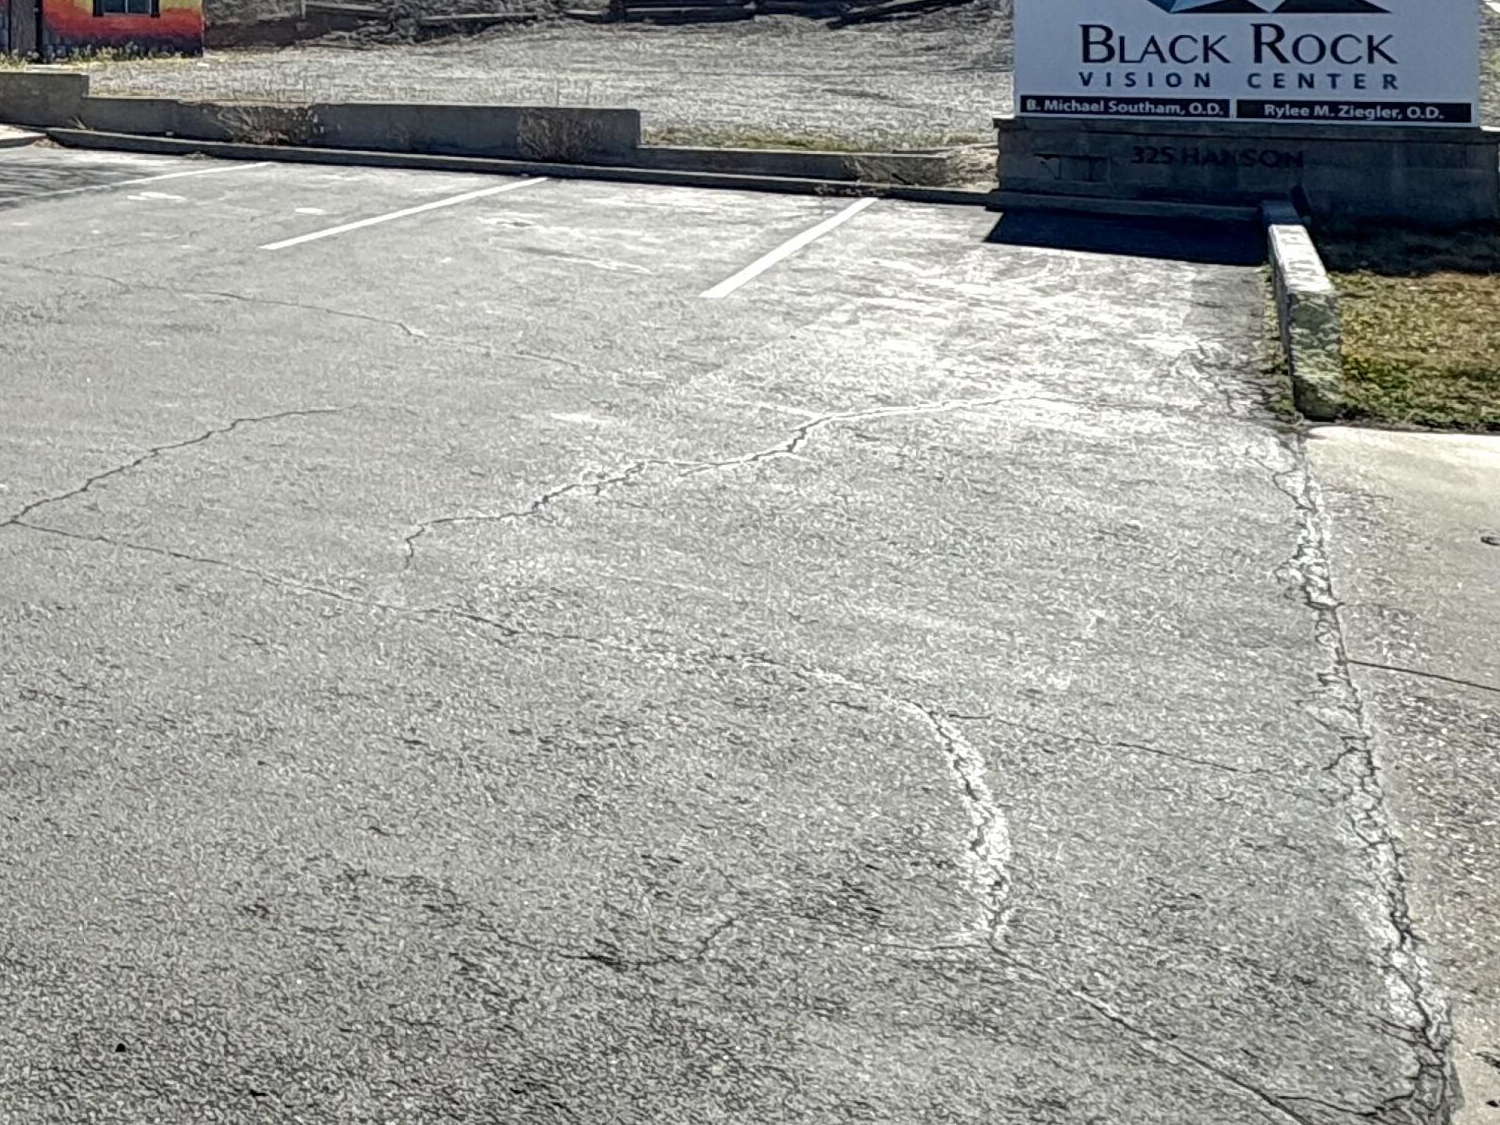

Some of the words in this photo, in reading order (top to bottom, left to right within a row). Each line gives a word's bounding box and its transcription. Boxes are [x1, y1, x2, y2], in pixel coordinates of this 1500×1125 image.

[1078, 24, 1231, 65] BLACK
[1250, 23, 1398, 65] ROCK
[1078, 71, 1211, 89] VISION
[1247, 72, 1398, 91] CENTER
[1044, 99, 1105, 113] Michael
[1110, 100, 1186, 116] Southam,
[1188, 102, 1225, 116] O.D.
[1263, 103, 1310, 119] Rylee
[1313, 104, 1335, 117] M.
[1337, 104, 1403, 122] Ziegler,
[1406, 105, 1445, 120] O.D.
[1130, 145, 1174, 165] 325
[1181, 146, 1303, 168] HANSON
